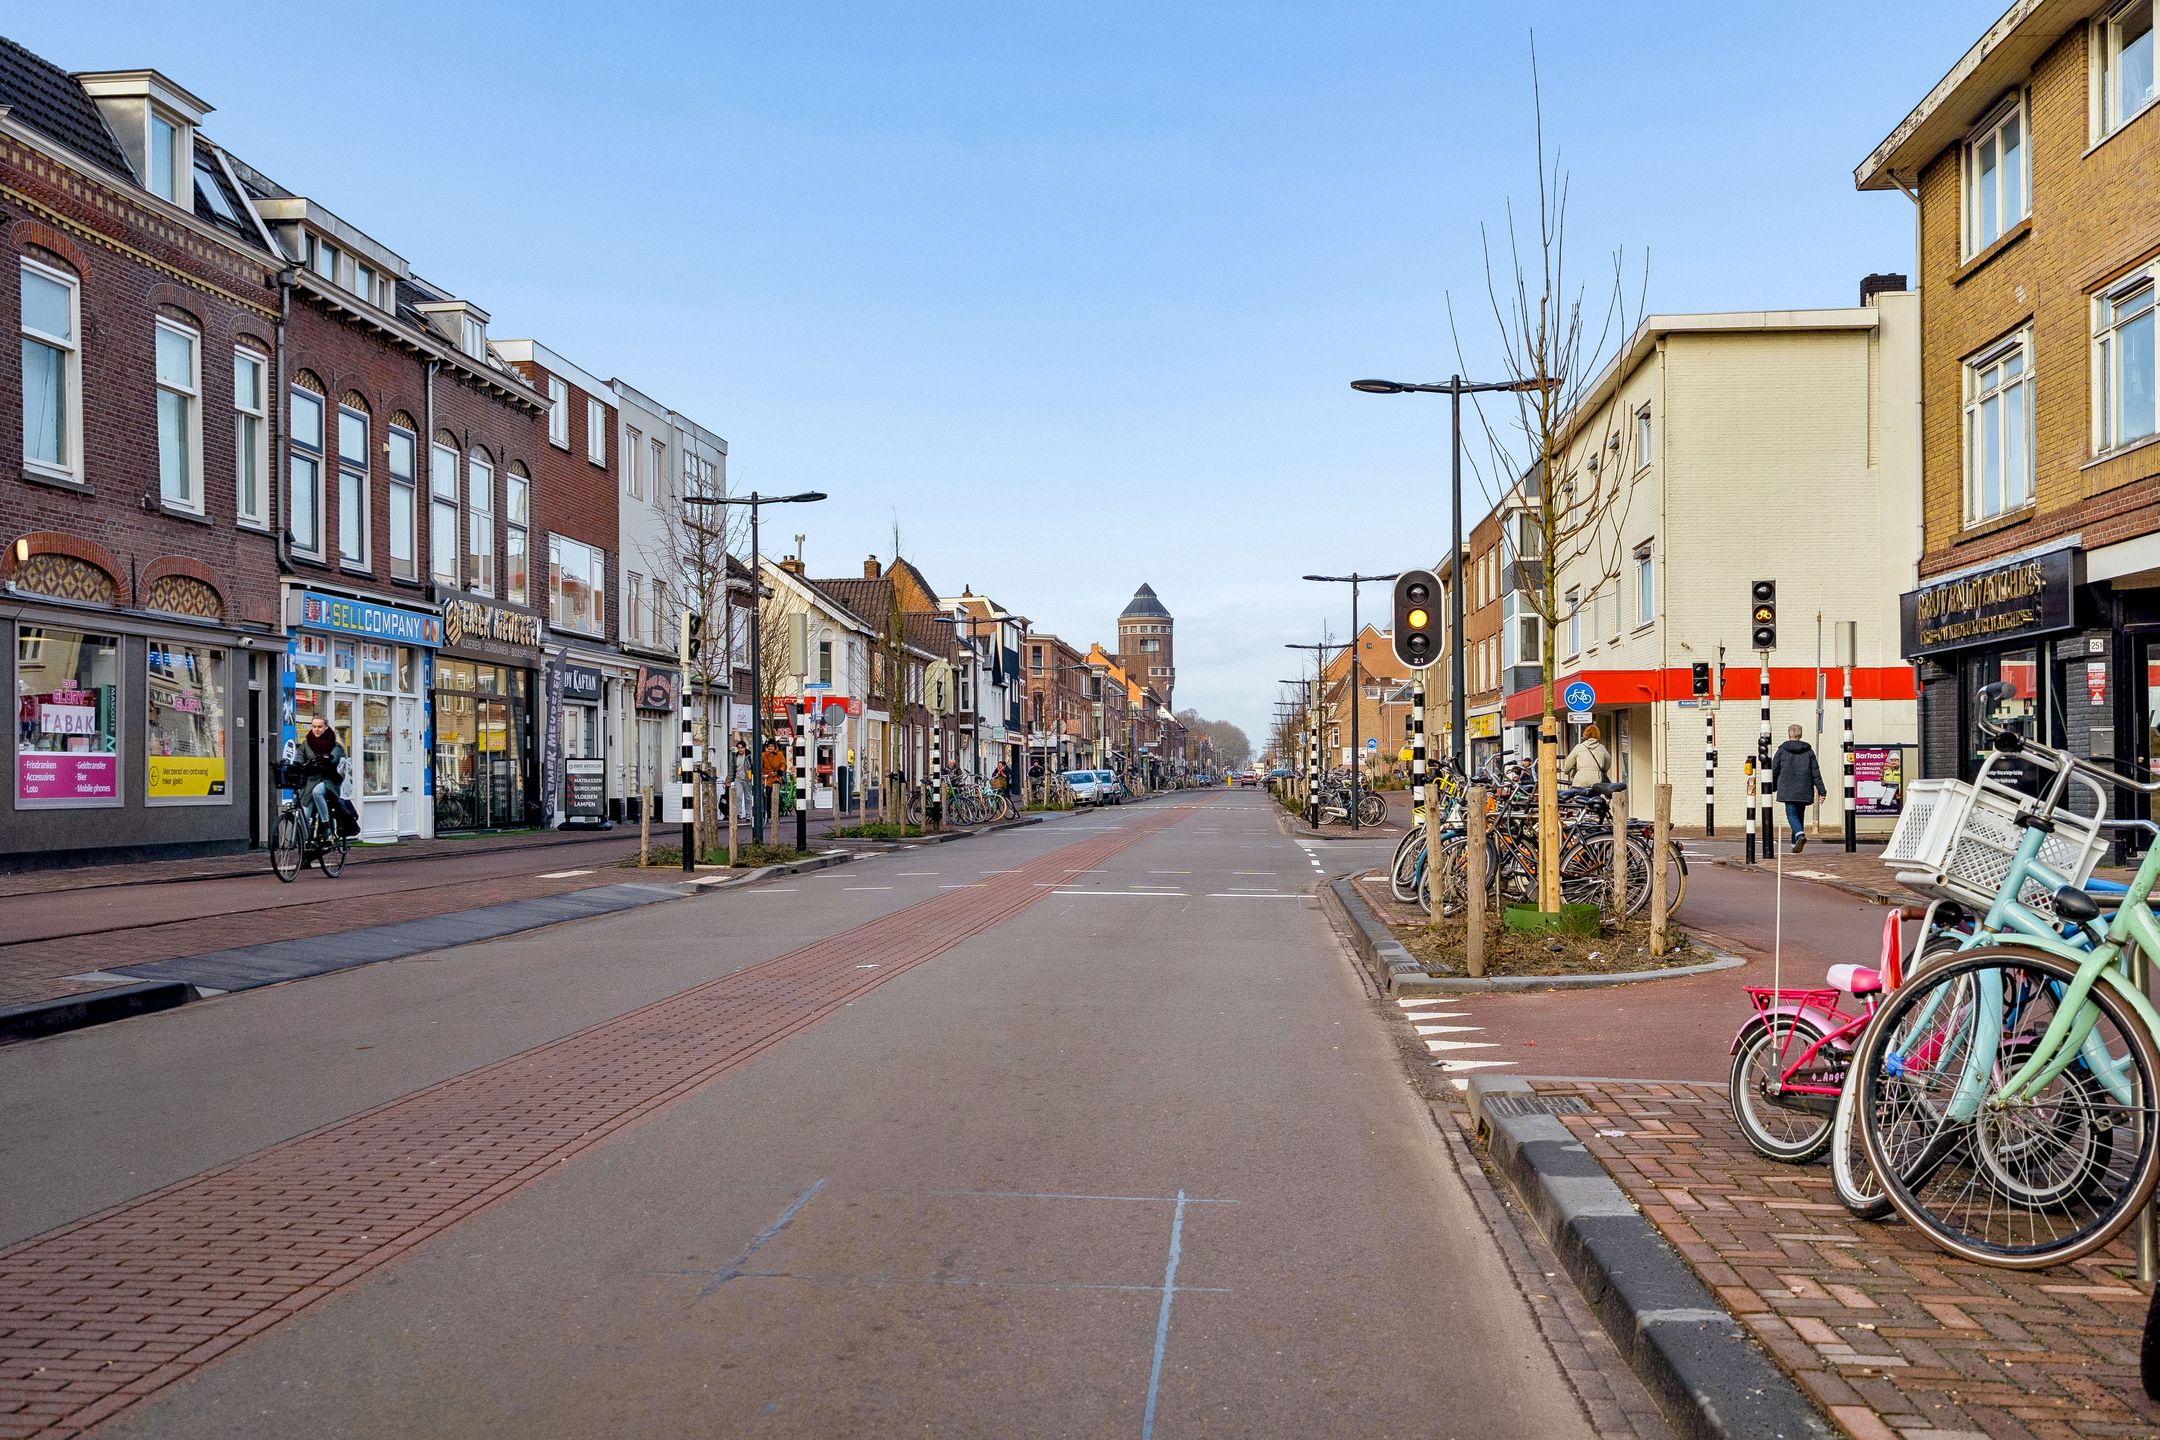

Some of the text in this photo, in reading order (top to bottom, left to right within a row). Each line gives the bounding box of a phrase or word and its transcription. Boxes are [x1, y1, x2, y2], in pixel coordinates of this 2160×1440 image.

[332, 603, 421, 639] SELLCOMPANY
[460, 638, 481, 650] VLOEREN
[564, 669, 597, 692] DY KAFTAN
[52, 688, 86, 705] GLORY
[43, 713, 94, 734] TABAK
[26, 760, 57, 770] Frisdranken
[77, 761, 107, 770] Geldtransfer
[26, 772, 55, 781] Accessoires
[77, 772, 88, 781] Bier
[162, 767, 182, 775] Verzend
[189, 768, 208, 777] ontvang
[172, 777, 183, 786] geld
[26, 785, 38, 793] Loto
[77, 784, 111, 794] Mobile phones
